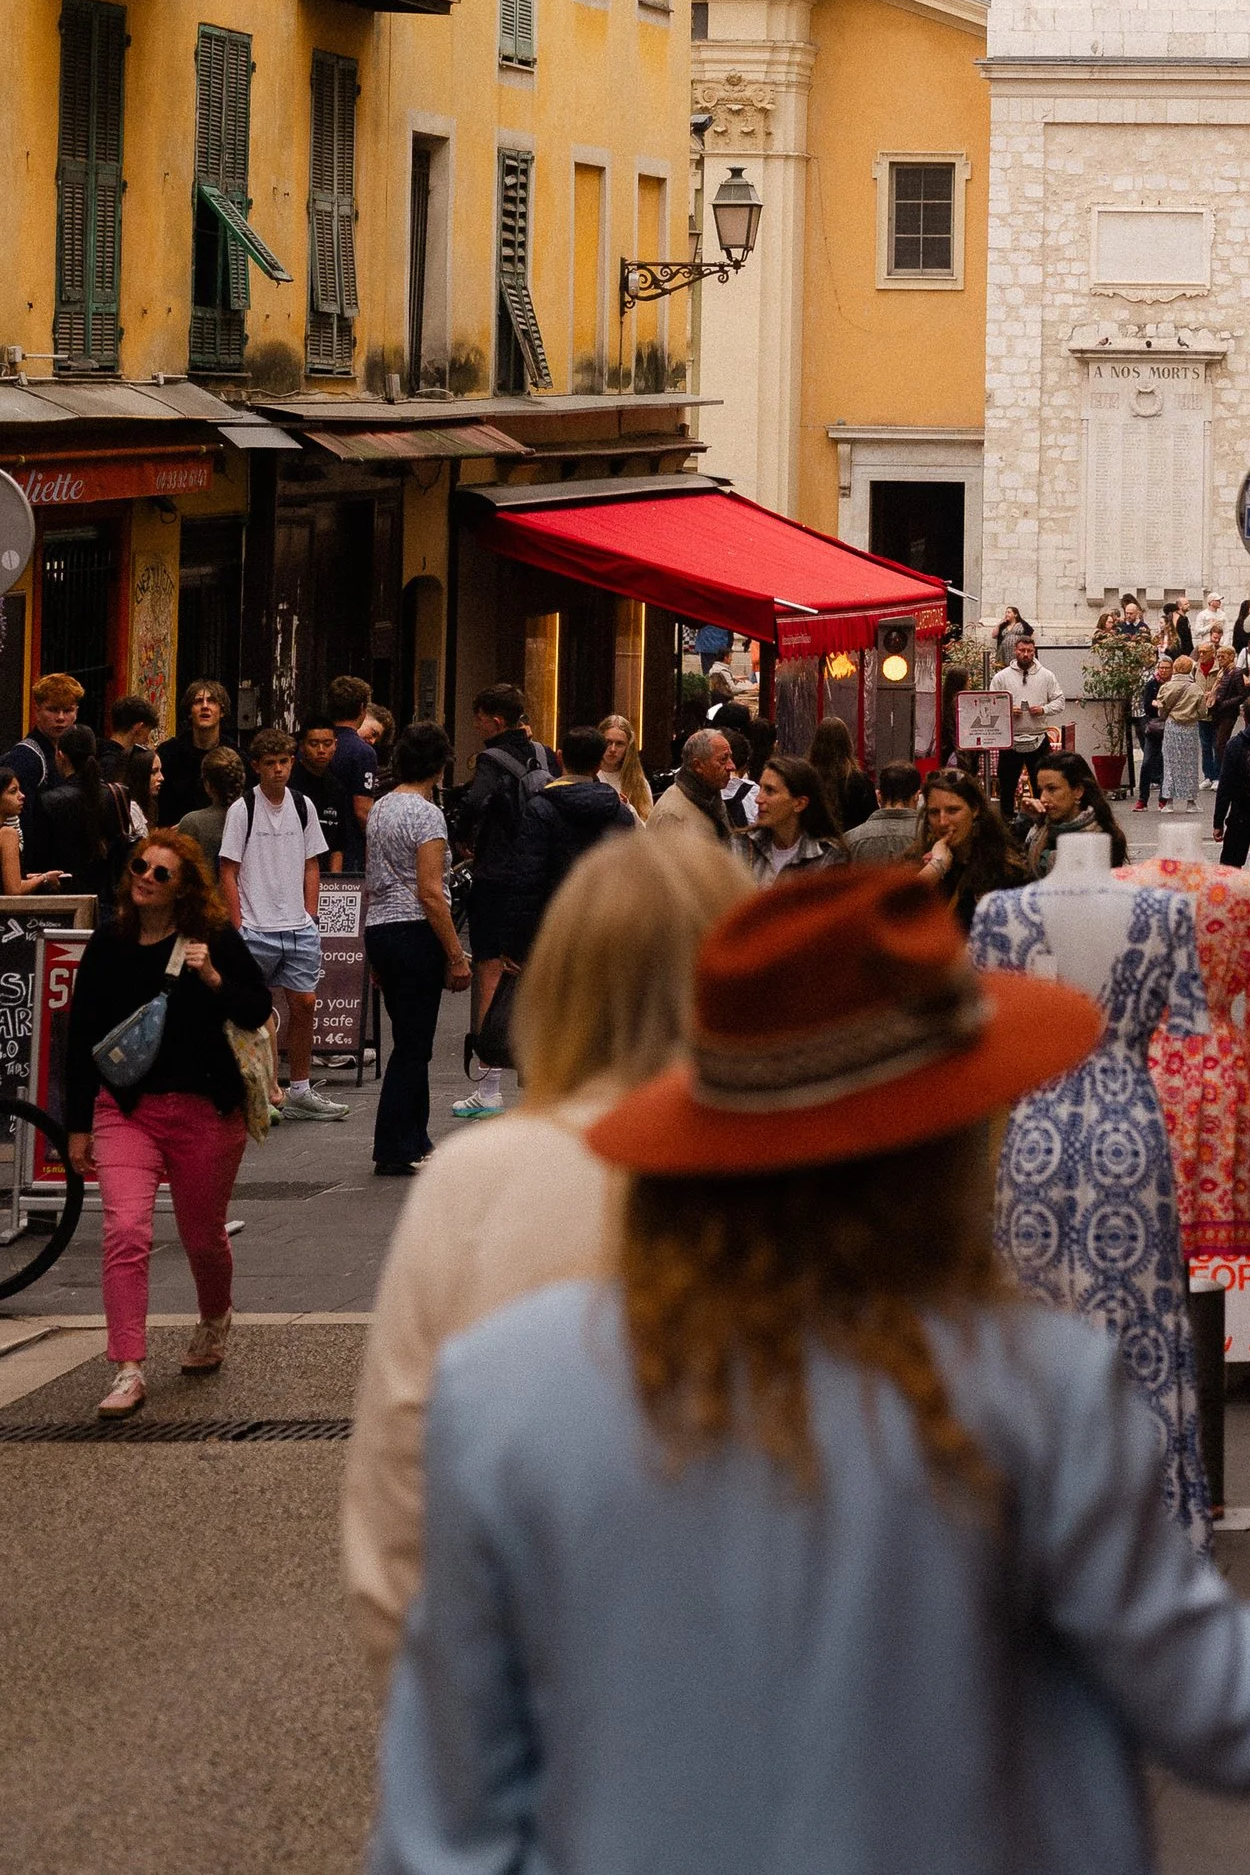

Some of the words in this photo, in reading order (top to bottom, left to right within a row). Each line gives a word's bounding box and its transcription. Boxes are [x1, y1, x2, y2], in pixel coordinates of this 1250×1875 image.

[1094, 366, 1102, 378] A
[1110, 366, 1140, 378] NOS
[1149, 366, 1200, 380] MORTS
[21, 469, 85, 503] liette
[319, 883, 340, 891] Book
[328, 998, 360, 1011] your
[323, 1014, 353, 1027] safe
